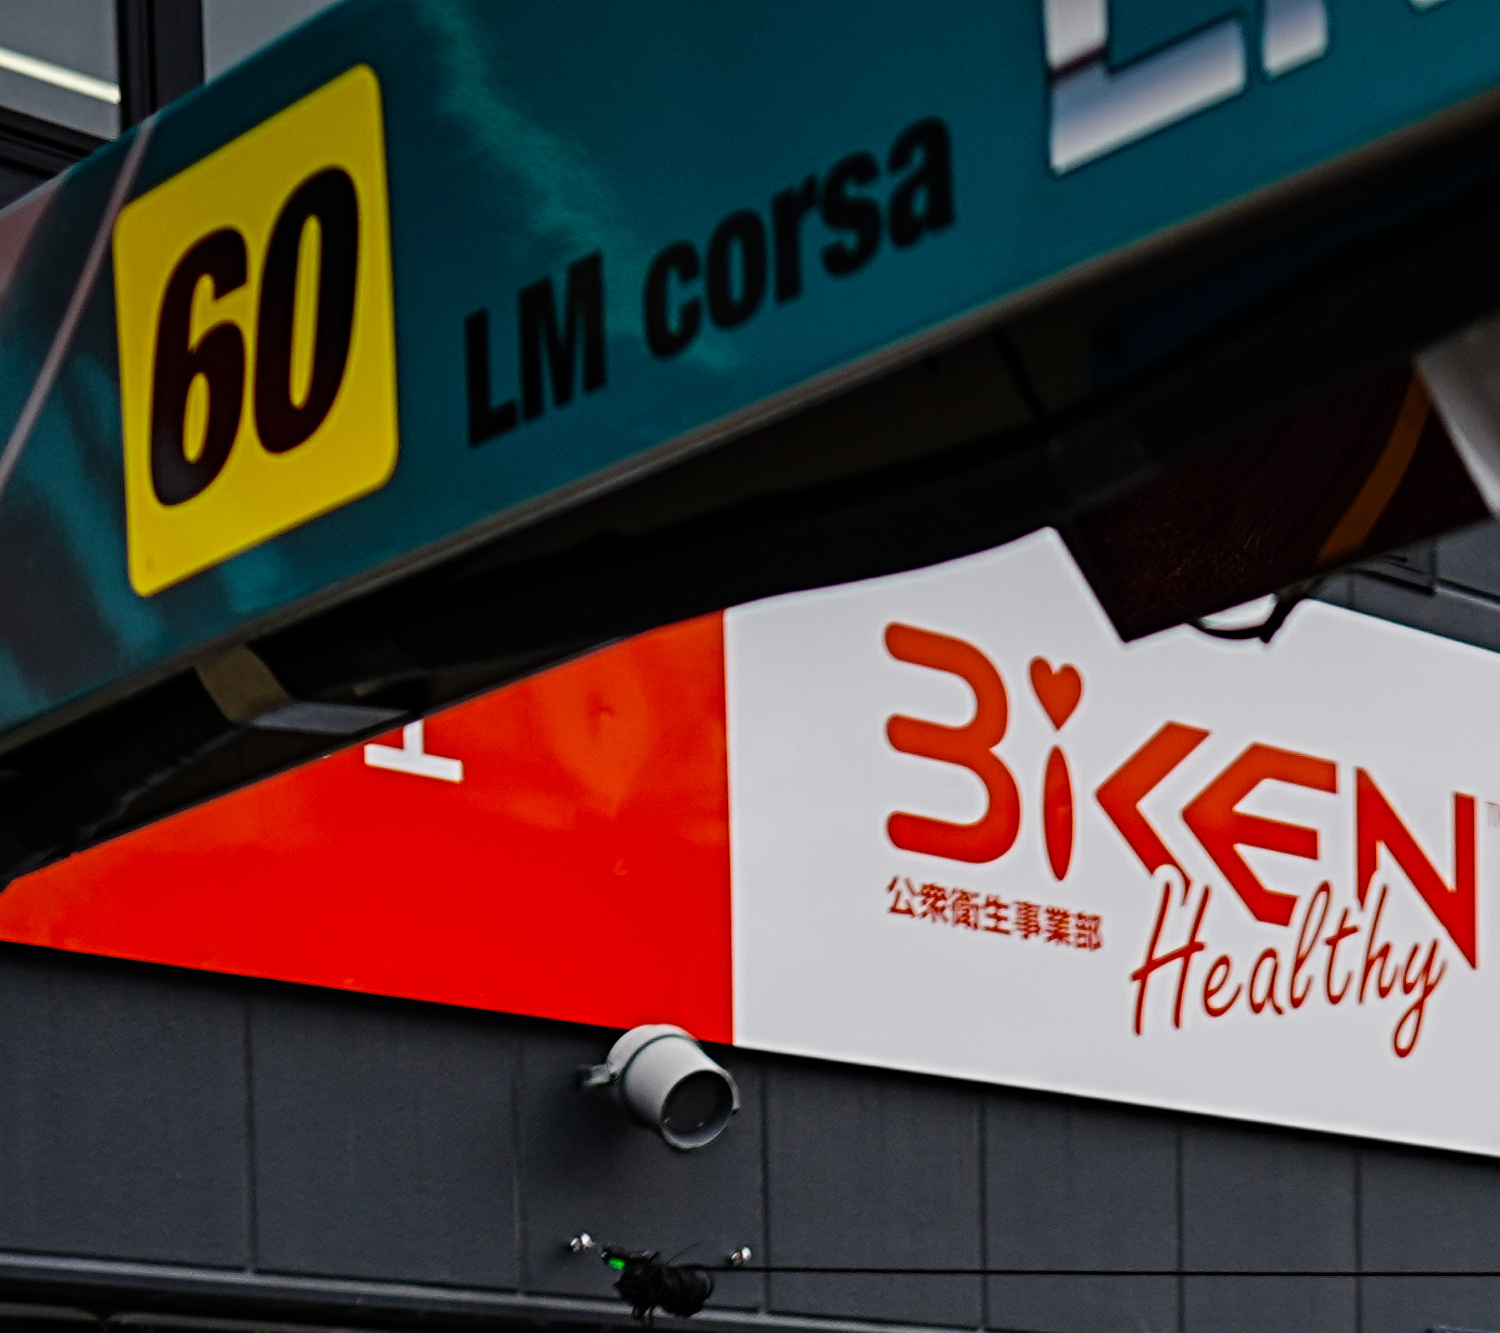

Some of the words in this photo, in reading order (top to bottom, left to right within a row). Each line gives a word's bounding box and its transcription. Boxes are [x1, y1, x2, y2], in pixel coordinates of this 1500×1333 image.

[148, 166, 361, 507] 60
[462, 250, 606, 446] LM
[642, 115, 955, 361] corsa
[1131, 863, 1447, 1059] Healthy
